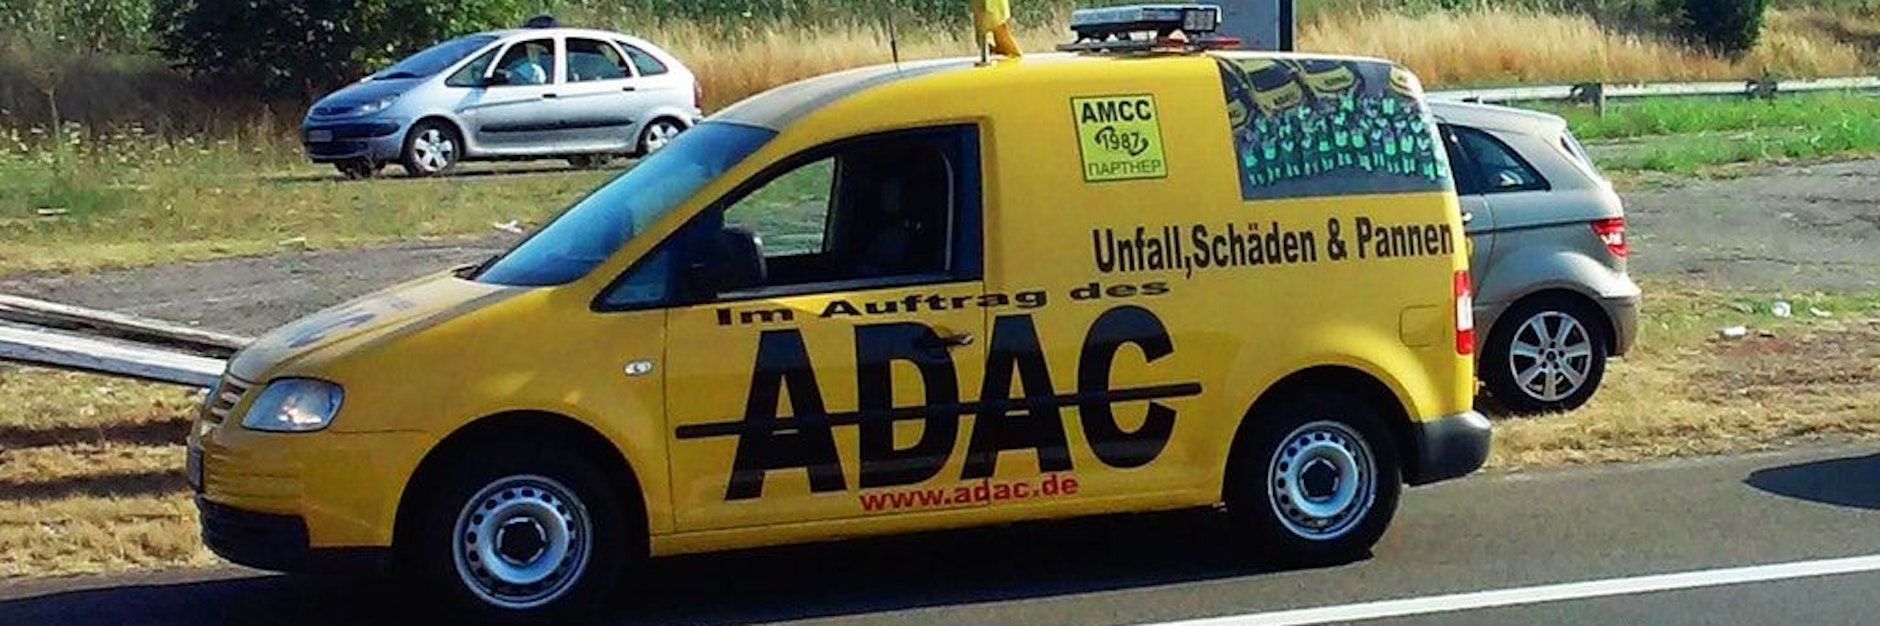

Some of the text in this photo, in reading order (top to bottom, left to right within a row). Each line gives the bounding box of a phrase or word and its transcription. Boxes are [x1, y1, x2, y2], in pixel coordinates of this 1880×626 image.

[1102, 132, 1140, 150] 1987
[1327, 217, 1348, 260] &
[1355, 215, 1455, 259] Pannen
[716, 282, 1169, 325] Im Auftrag des
[725, 304, 1178, 501] ADAC
[860, 474, 1079, 511] www.adac.de
